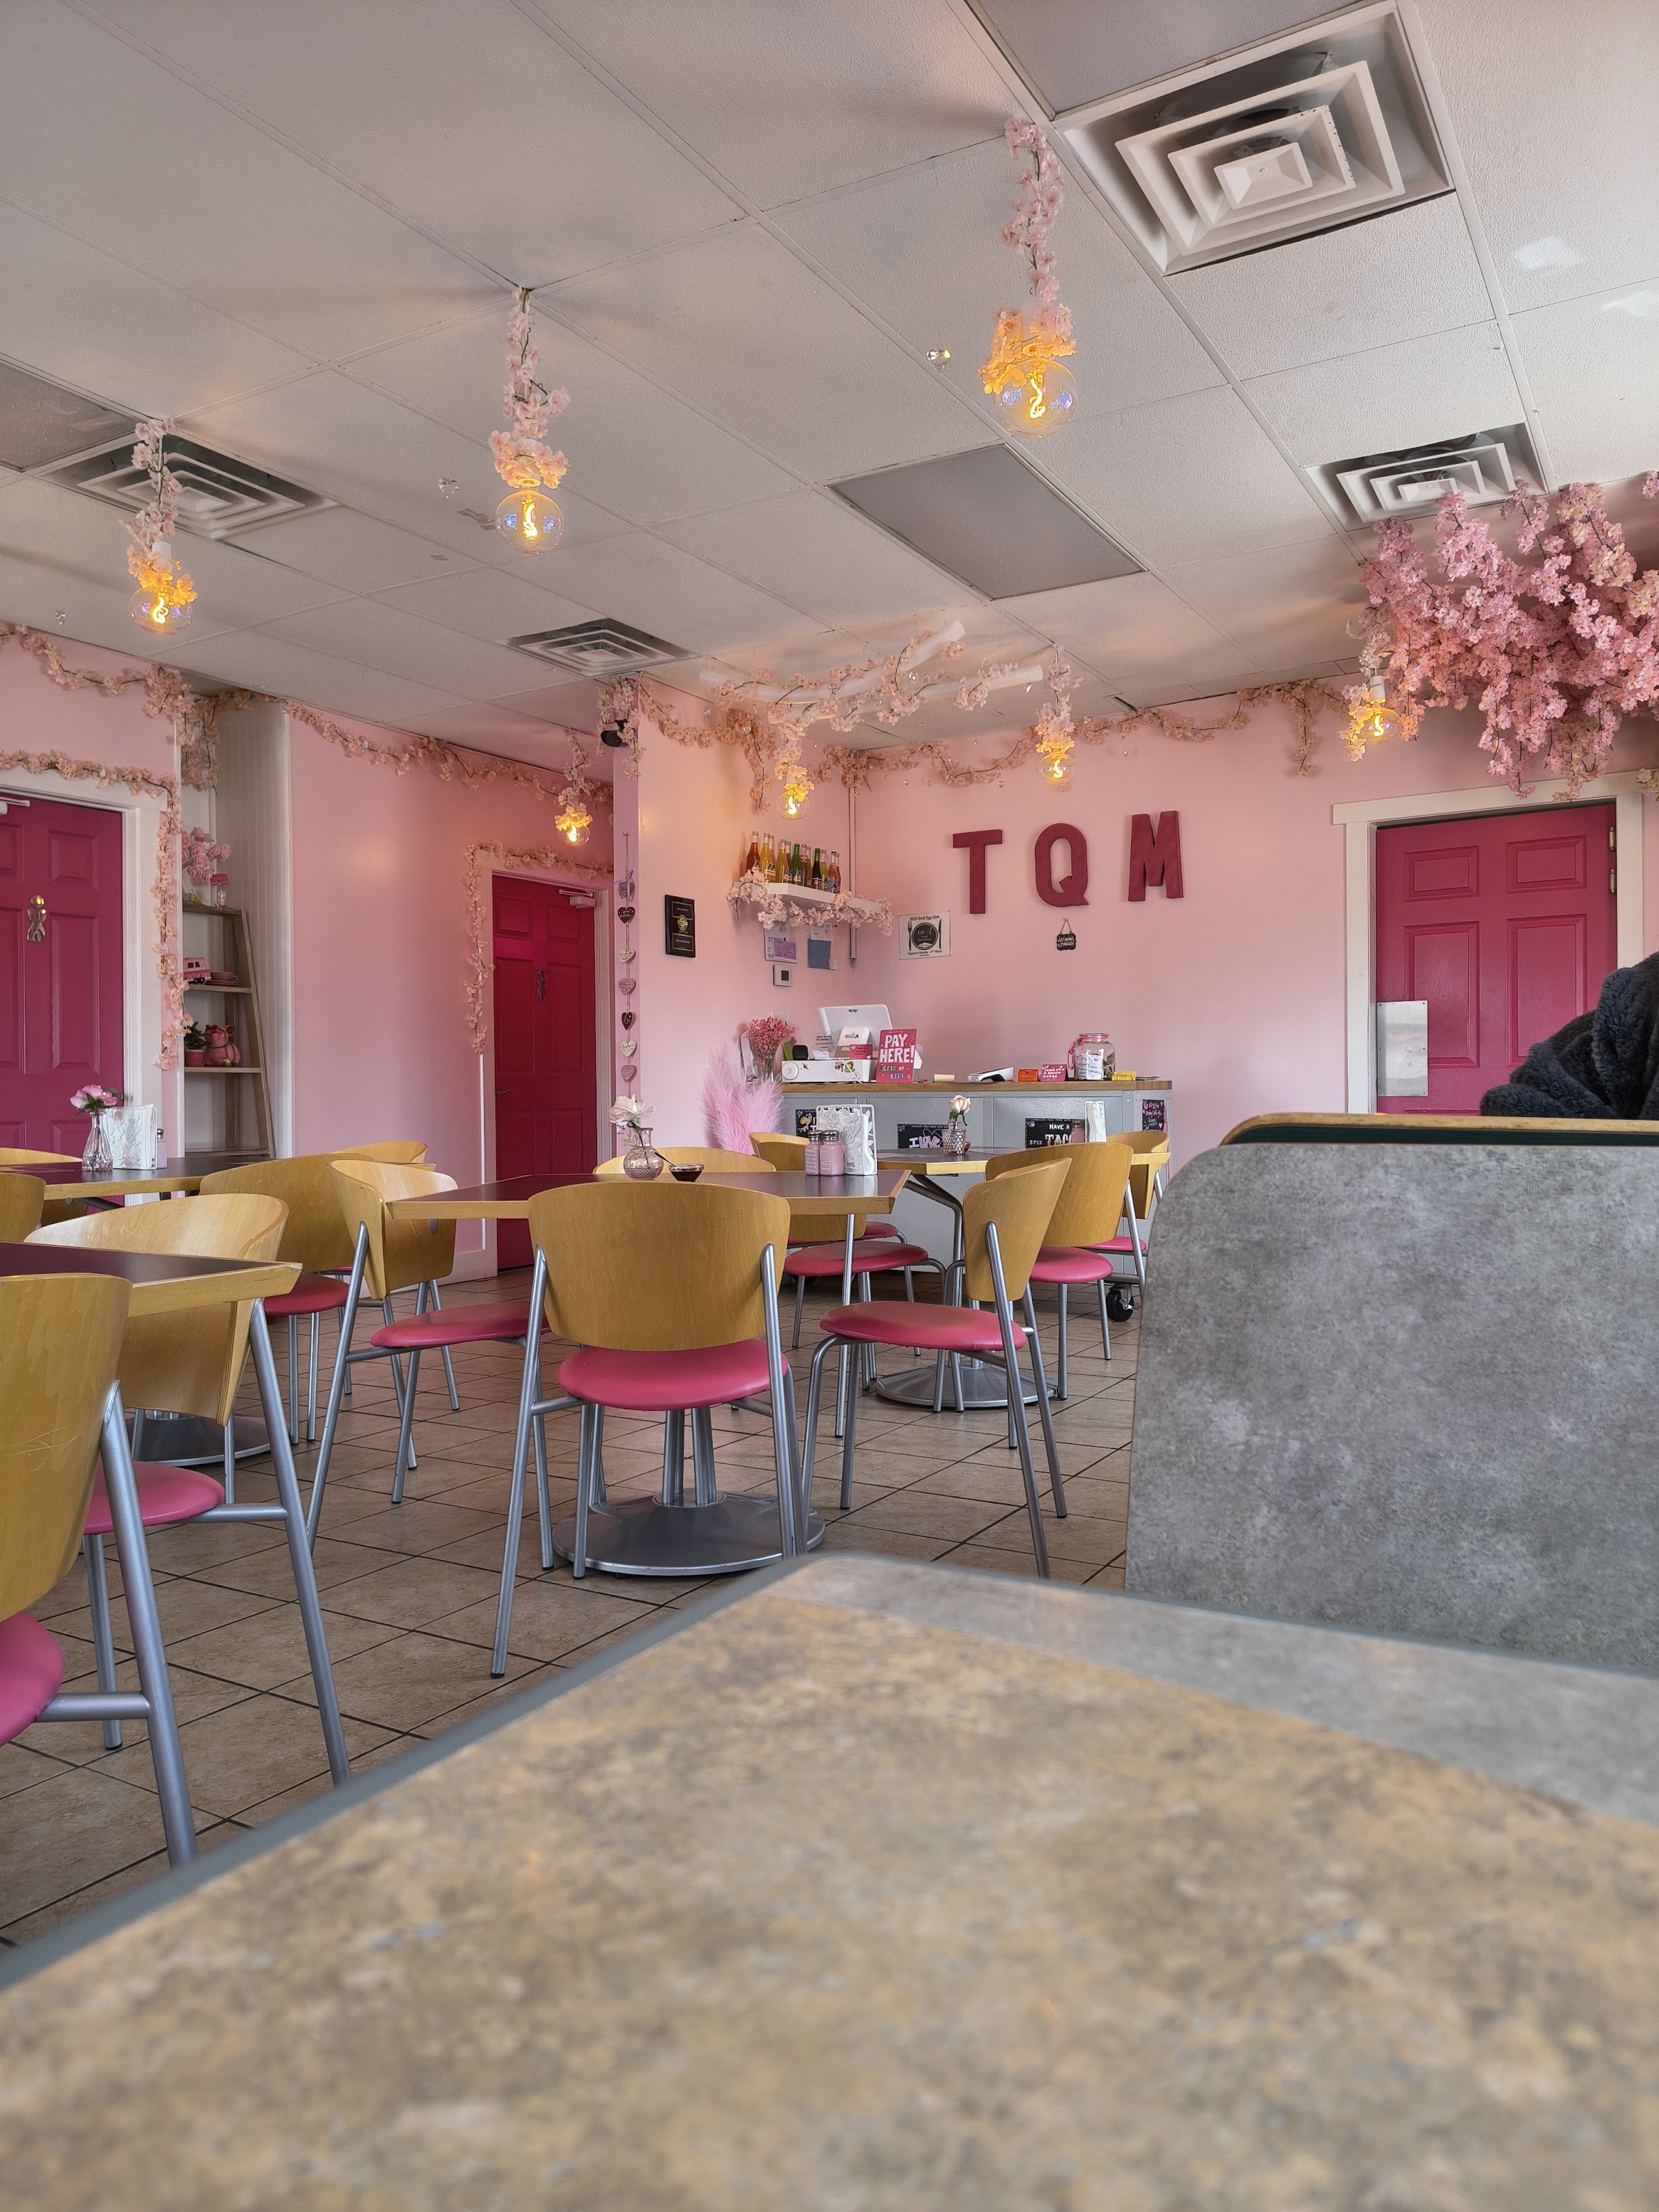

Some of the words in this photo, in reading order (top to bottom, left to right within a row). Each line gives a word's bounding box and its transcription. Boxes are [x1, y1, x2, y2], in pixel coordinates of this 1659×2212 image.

[885, 1033, 908, 1048] PAY
[879, 1044, 915, 1063] HERE!
[909, 1136, 920, 1149] I
[806, 1148, 816, 1172] PEPPER
[821, 1150, 832, 1172] SALT
